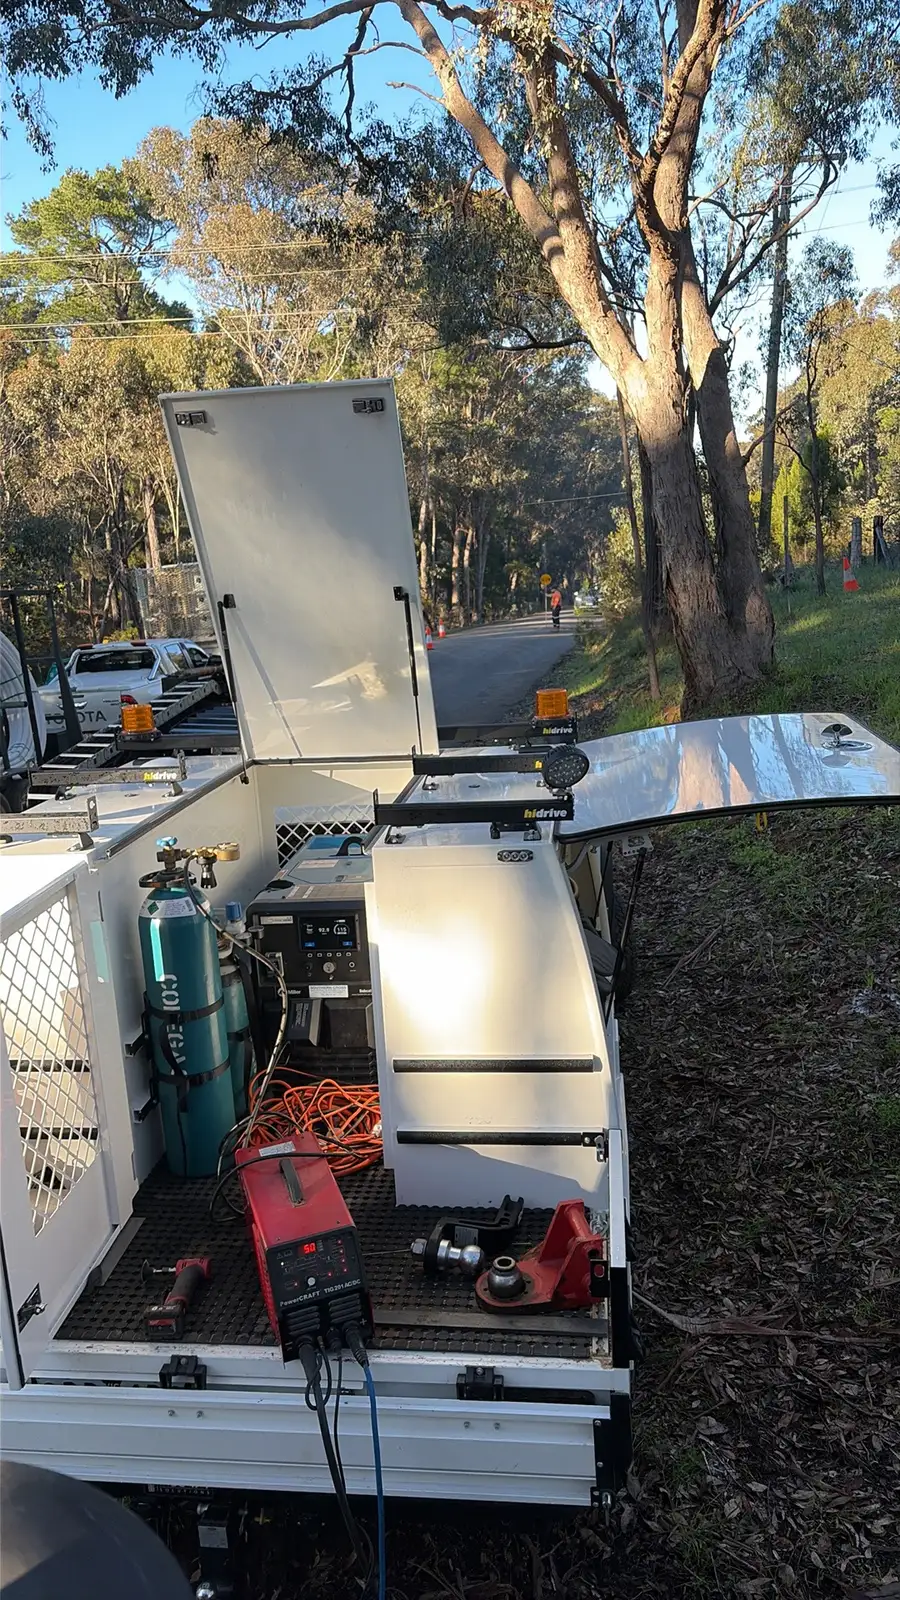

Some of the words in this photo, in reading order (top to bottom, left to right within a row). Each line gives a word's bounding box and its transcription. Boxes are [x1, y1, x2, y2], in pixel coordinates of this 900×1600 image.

[543, 727, 573, 735] hidrive
[524, 808, 567, 818] hidrive
[303, 1243, 315, 1254] 50
[280, 1291, 320, 1306] PowerCRAFT
